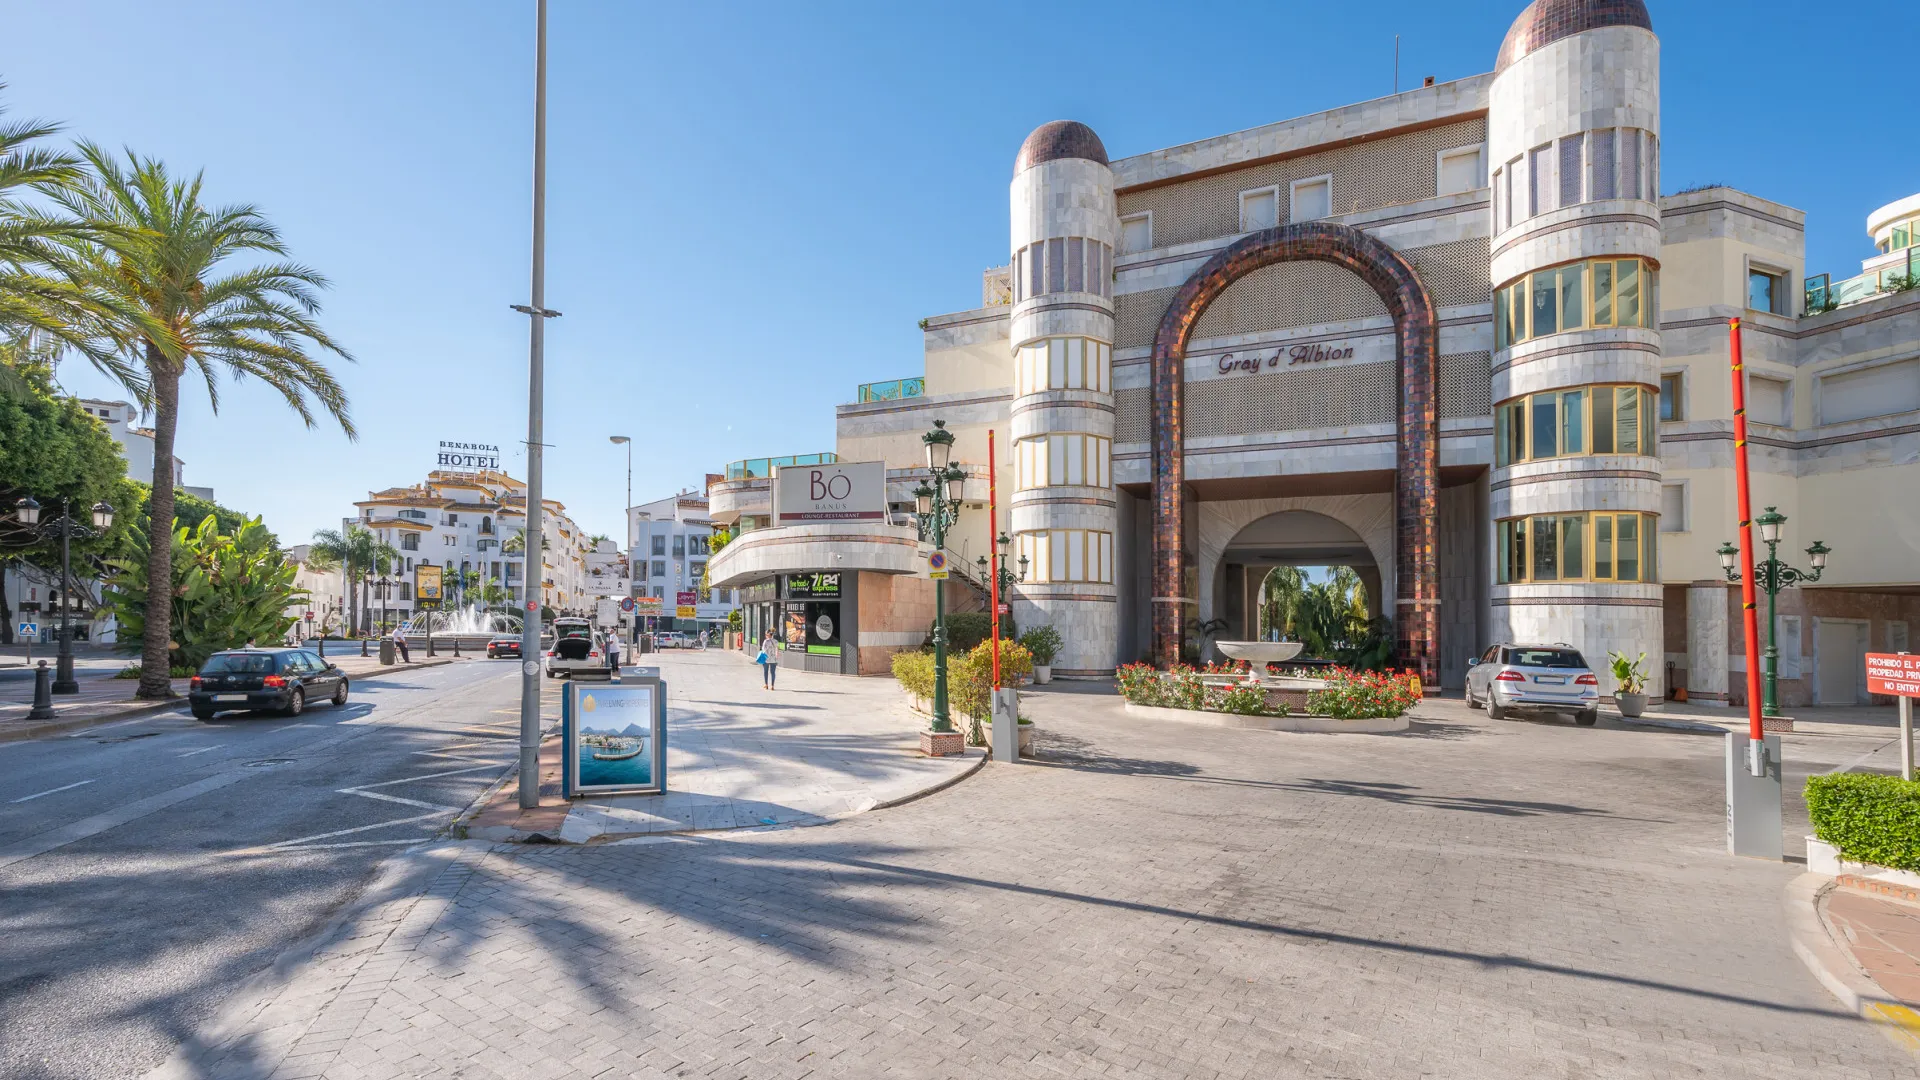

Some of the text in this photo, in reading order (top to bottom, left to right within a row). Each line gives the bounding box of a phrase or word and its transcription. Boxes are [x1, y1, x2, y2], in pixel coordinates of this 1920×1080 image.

[1219, 354, 1262, 374] Gray
[1288, 344, 1354, 366] Albion
[440, 441, 498, 451] BENABOLA
[438, 453, 499, 468] HOTEL
[1869, 658, 1901, 667] PROHIBIDO
[1904, 660, 1914, 669] EL
[1869, 668, 1903, 678] PROPIEDAD
[1884, 682, 1919, 692] NO ENTRY
